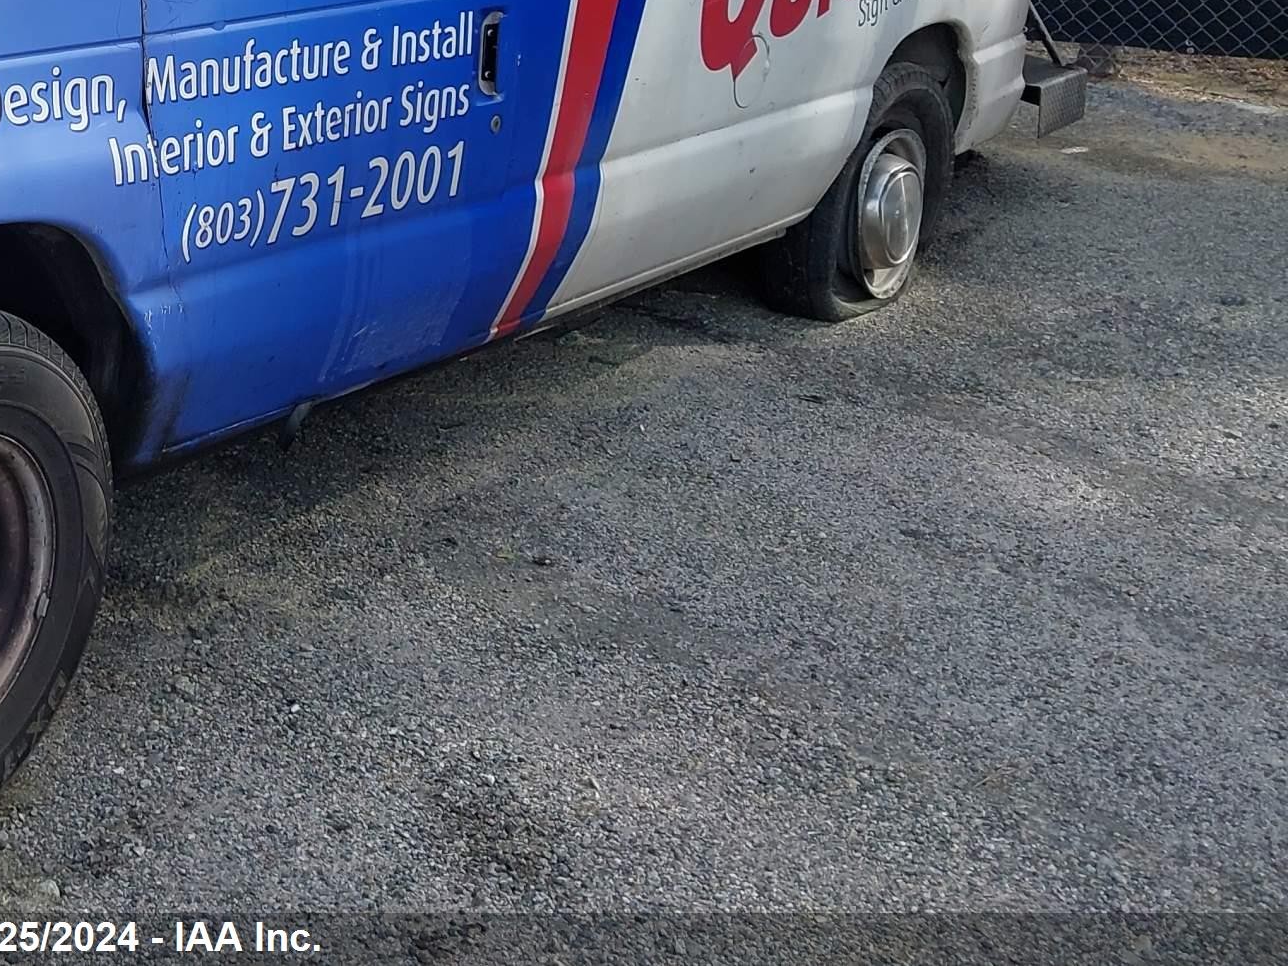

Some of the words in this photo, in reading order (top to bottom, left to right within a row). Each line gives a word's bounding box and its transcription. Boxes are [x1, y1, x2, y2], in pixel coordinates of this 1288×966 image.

[144, 39, 351, 106] Manufacture
[361, 27, 382, 71] &
[391, 10, 475, 67] Install
[108, 119, 241, 187] Interior
[250, 111, 271, 159] &
[281, 91, 391, 152] Exterior
[397, 79, 471, 129] Signs
